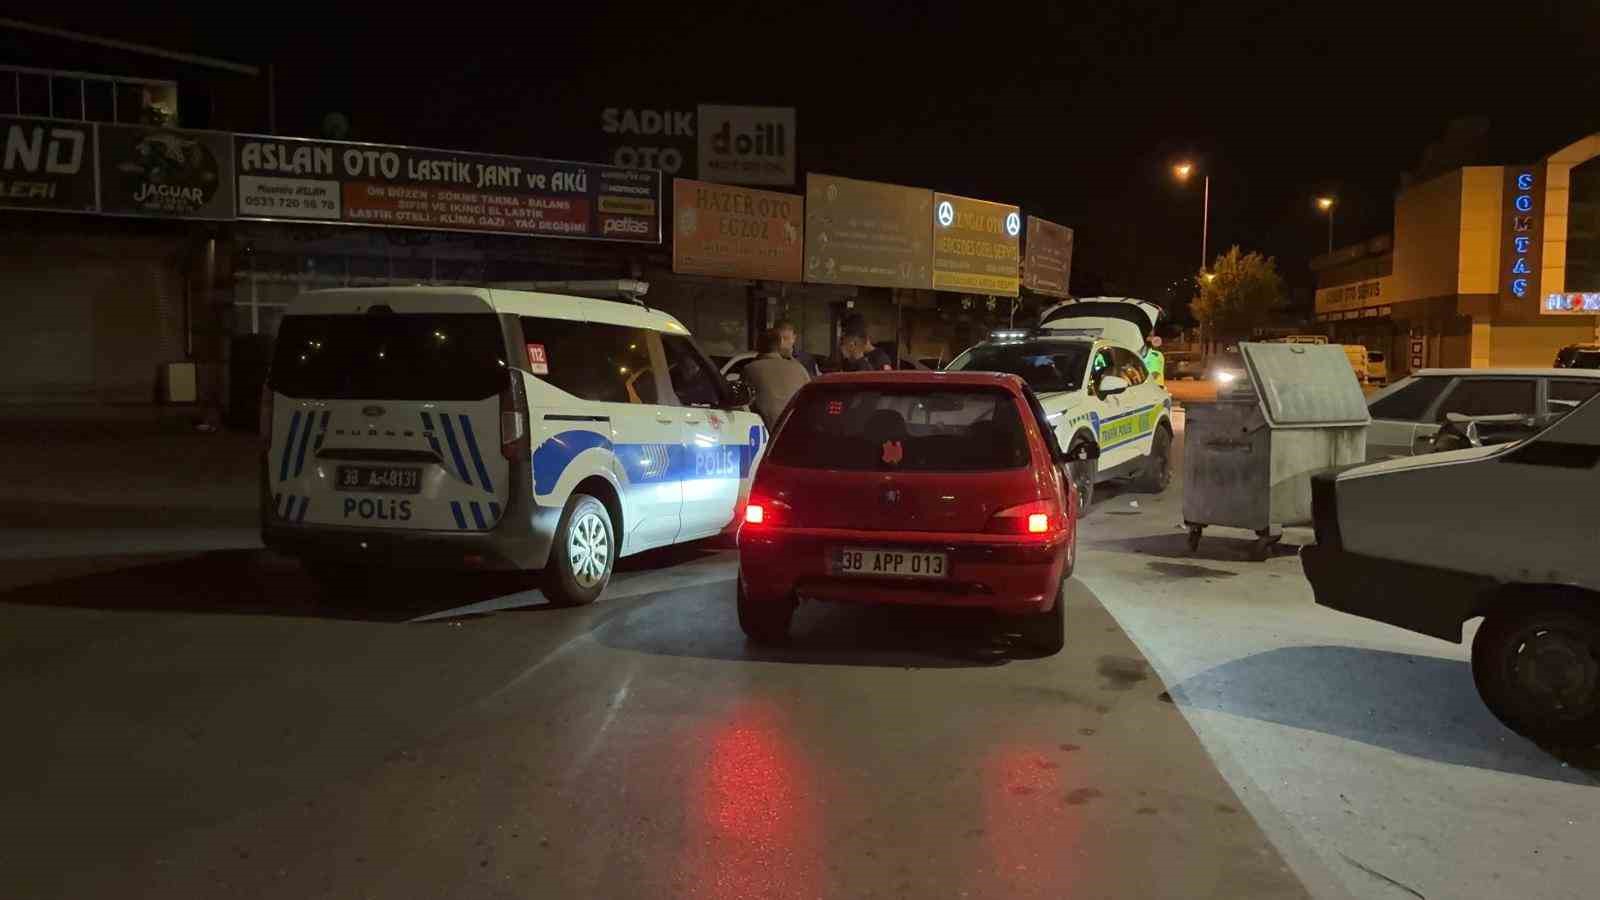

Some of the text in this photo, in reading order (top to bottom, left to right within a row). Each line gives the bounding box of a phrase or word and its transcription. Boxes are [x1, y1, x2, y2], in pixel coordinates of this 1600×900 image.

[601, 106, 696, 137] SADIK
[241, 142, 334, 176] ASLAN
[343, 149, 401, 179] OTO
[408, 158, 472, 184] LASTİK
[476, 163, 522, 189] JANT
[527, 174, 546, 189] ve
[551, 167, 587, 193] AKÜ
[614, 144, 682, 175] OTO
[133, 184, 204, 205] JAGUAR
[529, 347, 545, 362] 112
[843, 551, 942, 575] 38 APP 013
